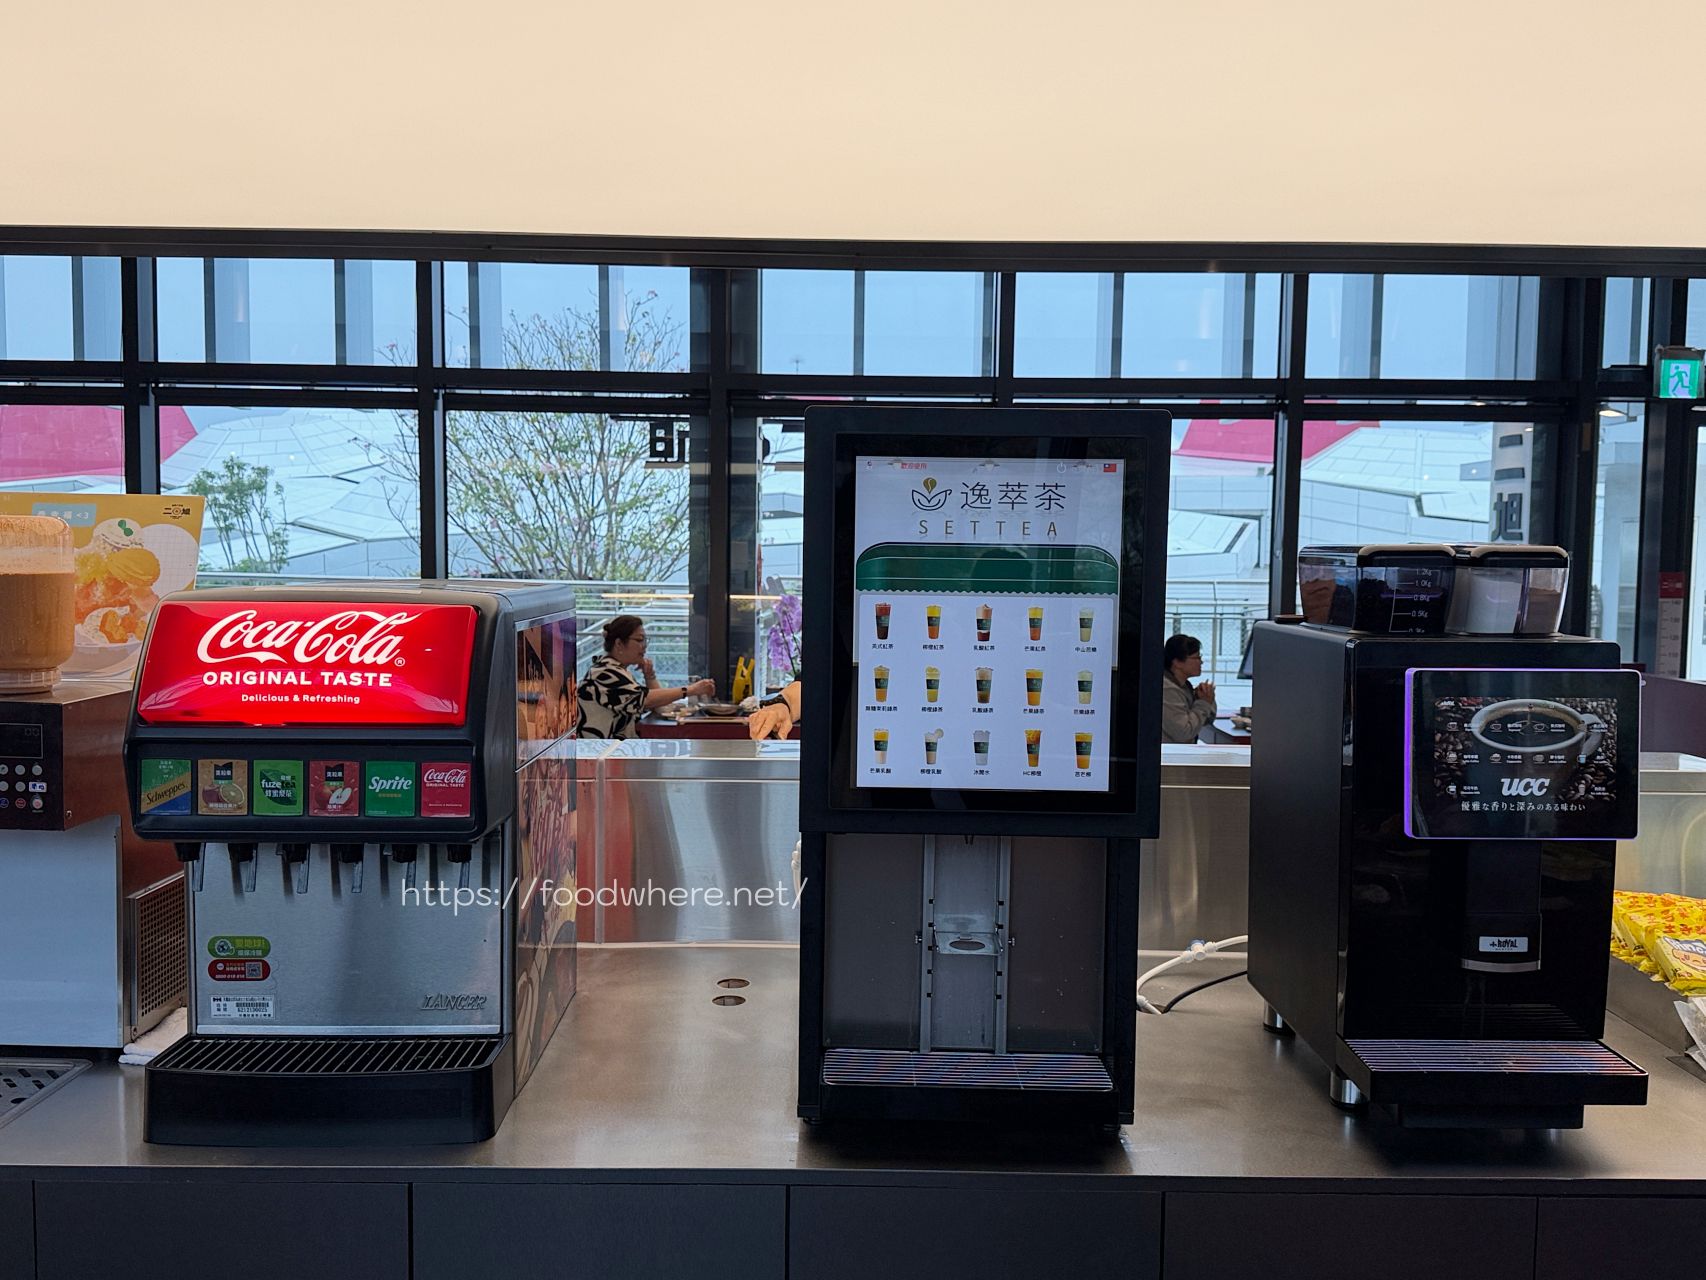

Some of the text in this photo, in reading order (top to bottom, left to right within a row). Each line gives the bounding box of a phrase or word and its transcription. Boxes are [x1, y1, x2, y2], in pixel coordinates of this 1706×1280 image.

[960, 481, 1066, 511] 逸萃茶
[197, 609, 423, 665] Coca-Cola
[202, 671, 393, 687] ORIGINAL TASTE
[241, 693, 360, 704] Delicious & Refreshing
[368, 775, 413, 792] Sprite
[424, 768, 468, 783] Coca-Cola
[145, 781, 186, 805] Schweppes
[1461, 801, 1586, 812] 優雅な香りと深みのある味わい
